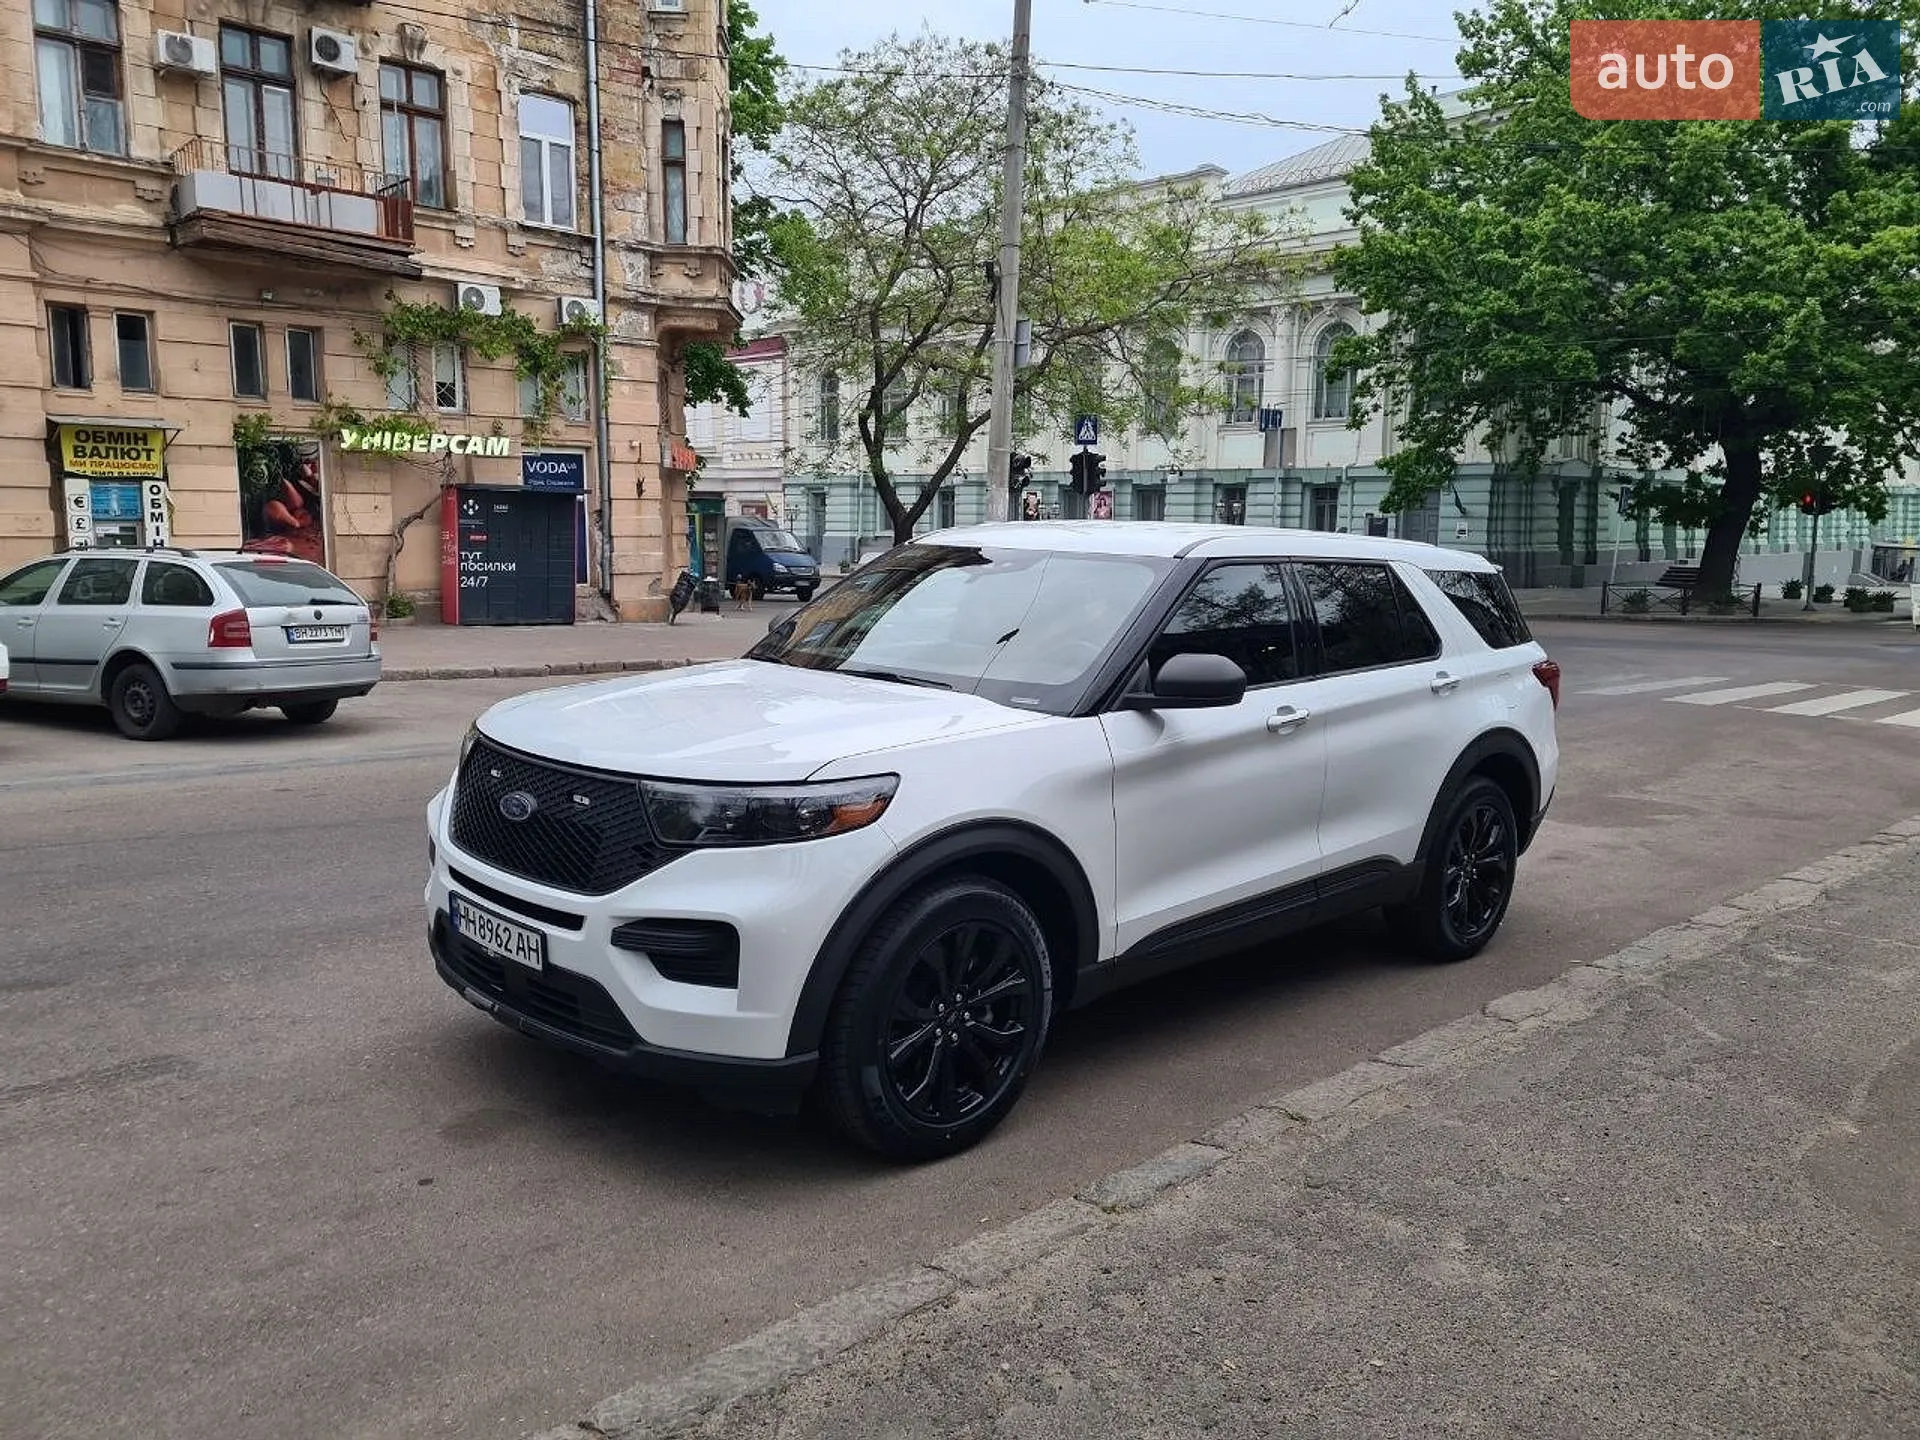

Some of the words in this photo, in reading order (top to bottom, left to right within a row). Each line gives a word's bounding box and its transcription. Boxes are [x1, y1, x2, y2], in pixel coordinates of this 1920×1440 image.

[74, 429, 148, 446] ОБМІН
[73, 445, 155, 461] ВАЛЮТ
[526, 461, 568, 474] VODA
[460, 576, 488, 588] 24/7
[478, 914, 513, 955] 8962
[516, 932, 540, 965] AH
